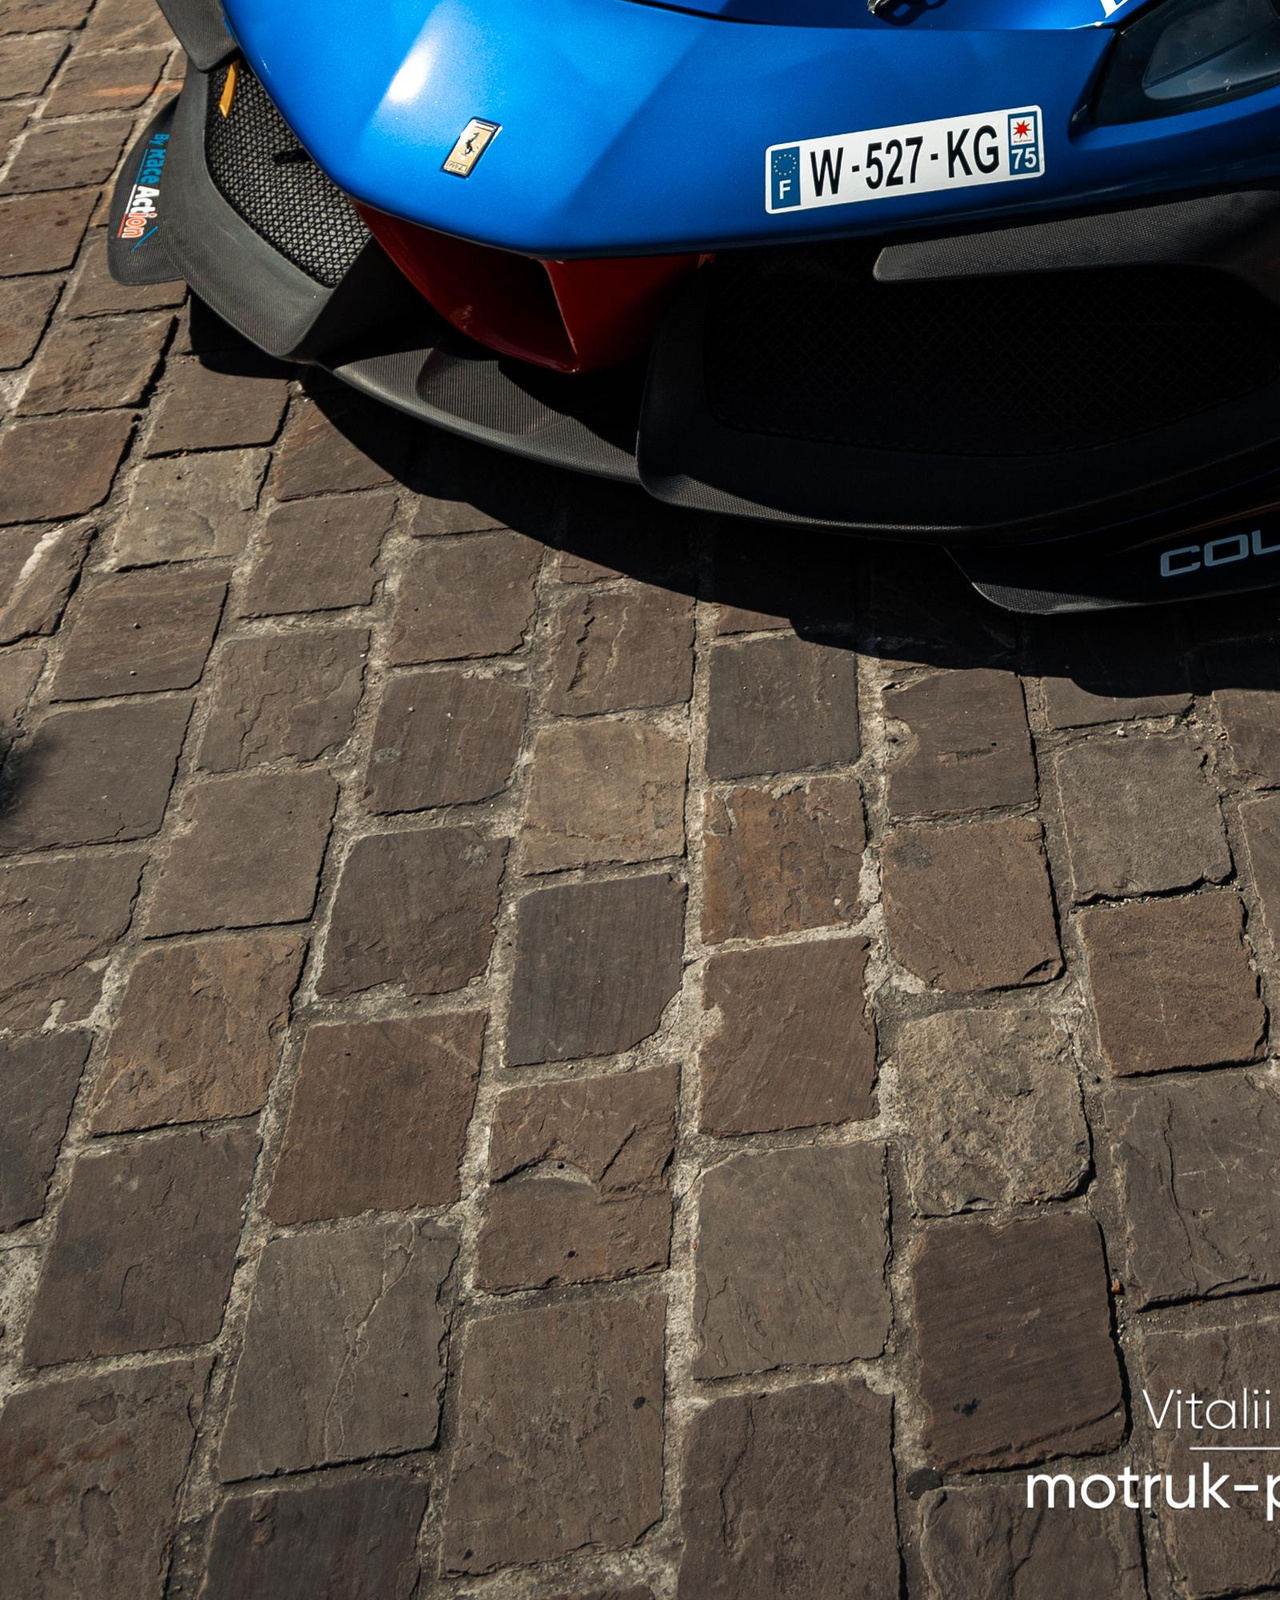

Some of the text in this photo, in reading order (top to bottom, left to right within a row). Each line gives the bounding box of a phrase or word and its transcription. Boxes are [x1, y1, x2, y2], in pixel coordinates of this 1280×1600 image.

[149, 133, 170, 146] By
[1011, 147, 1037, 170] 75
[778, 179, 792, 200] F
